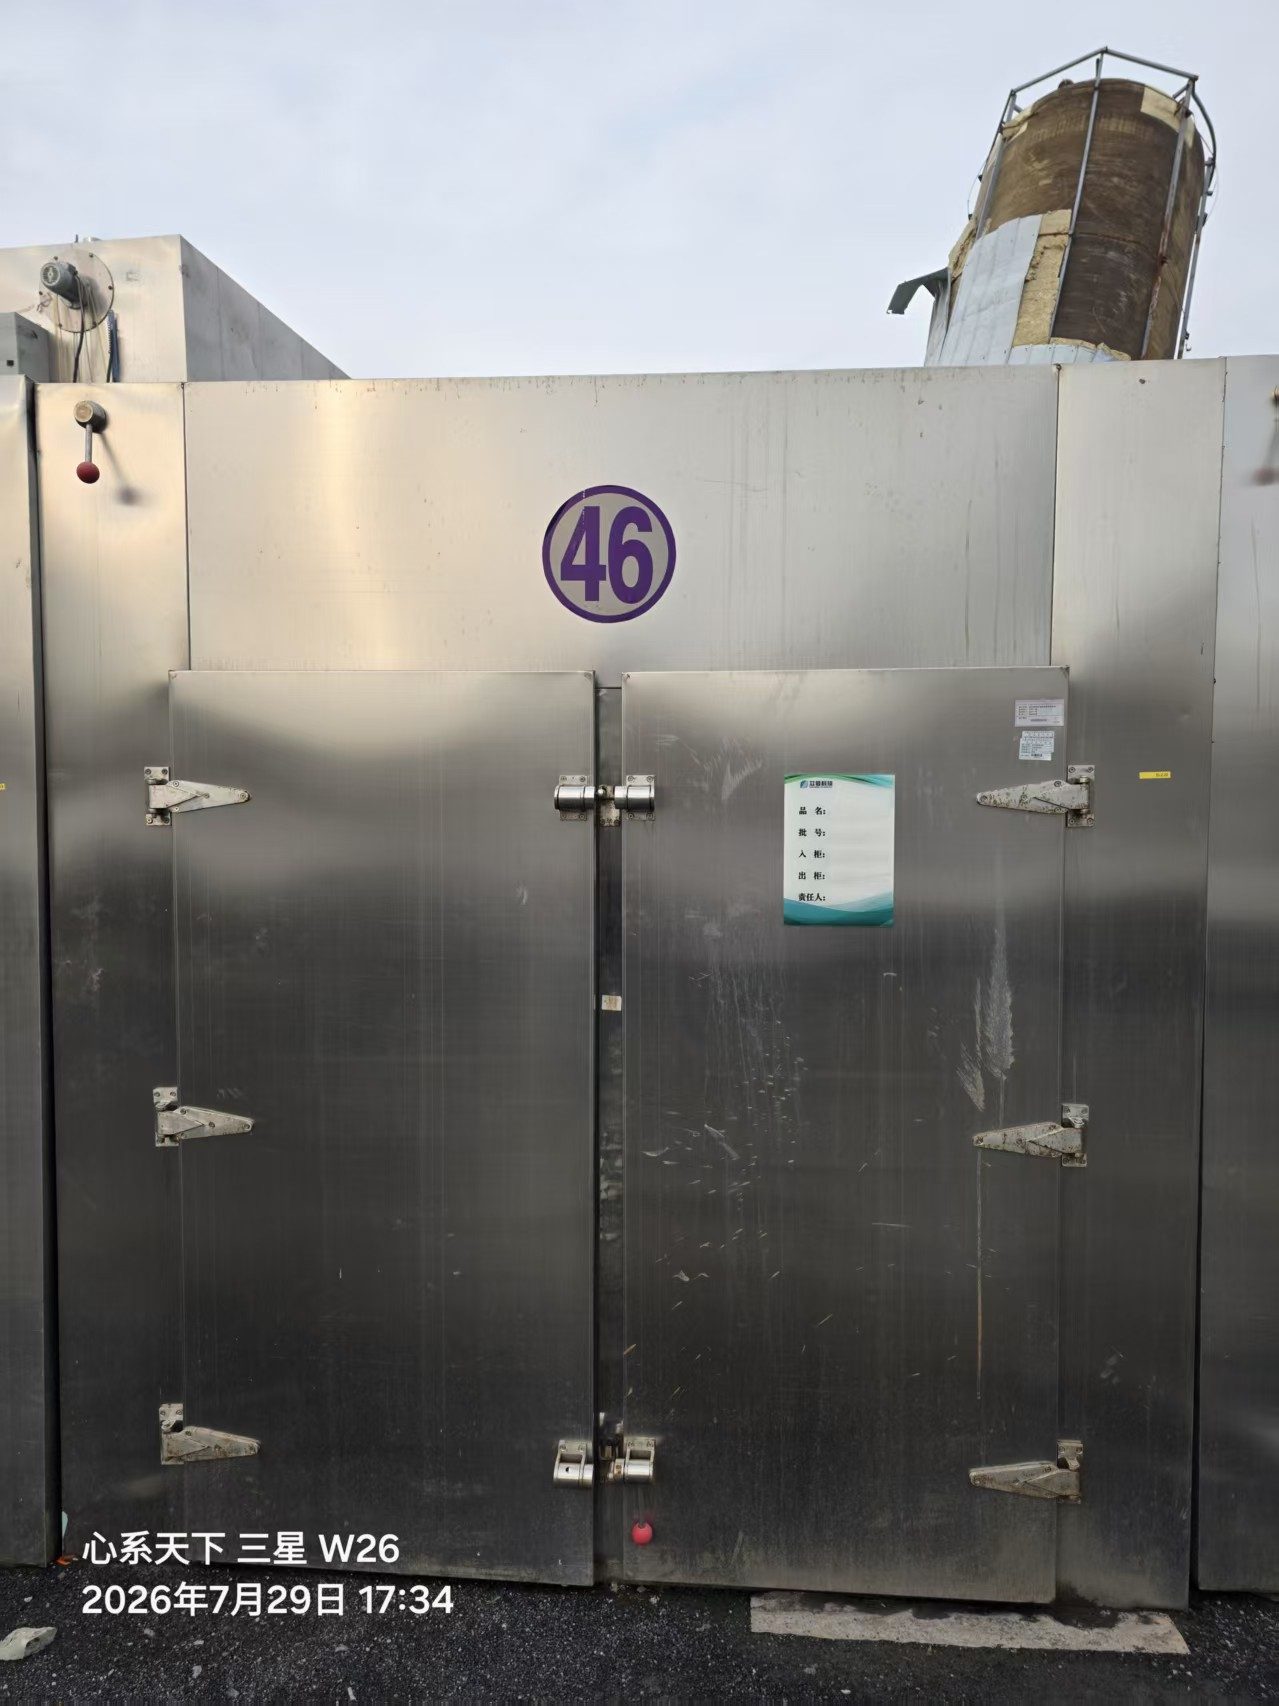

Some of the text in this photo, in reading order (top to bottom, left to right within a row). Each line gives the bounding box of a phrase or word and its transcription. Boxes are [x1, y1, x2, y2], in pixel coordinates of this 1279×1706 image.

[560, 505, 653, 604] 46
[798, 893, 826, 902] 责任人:
